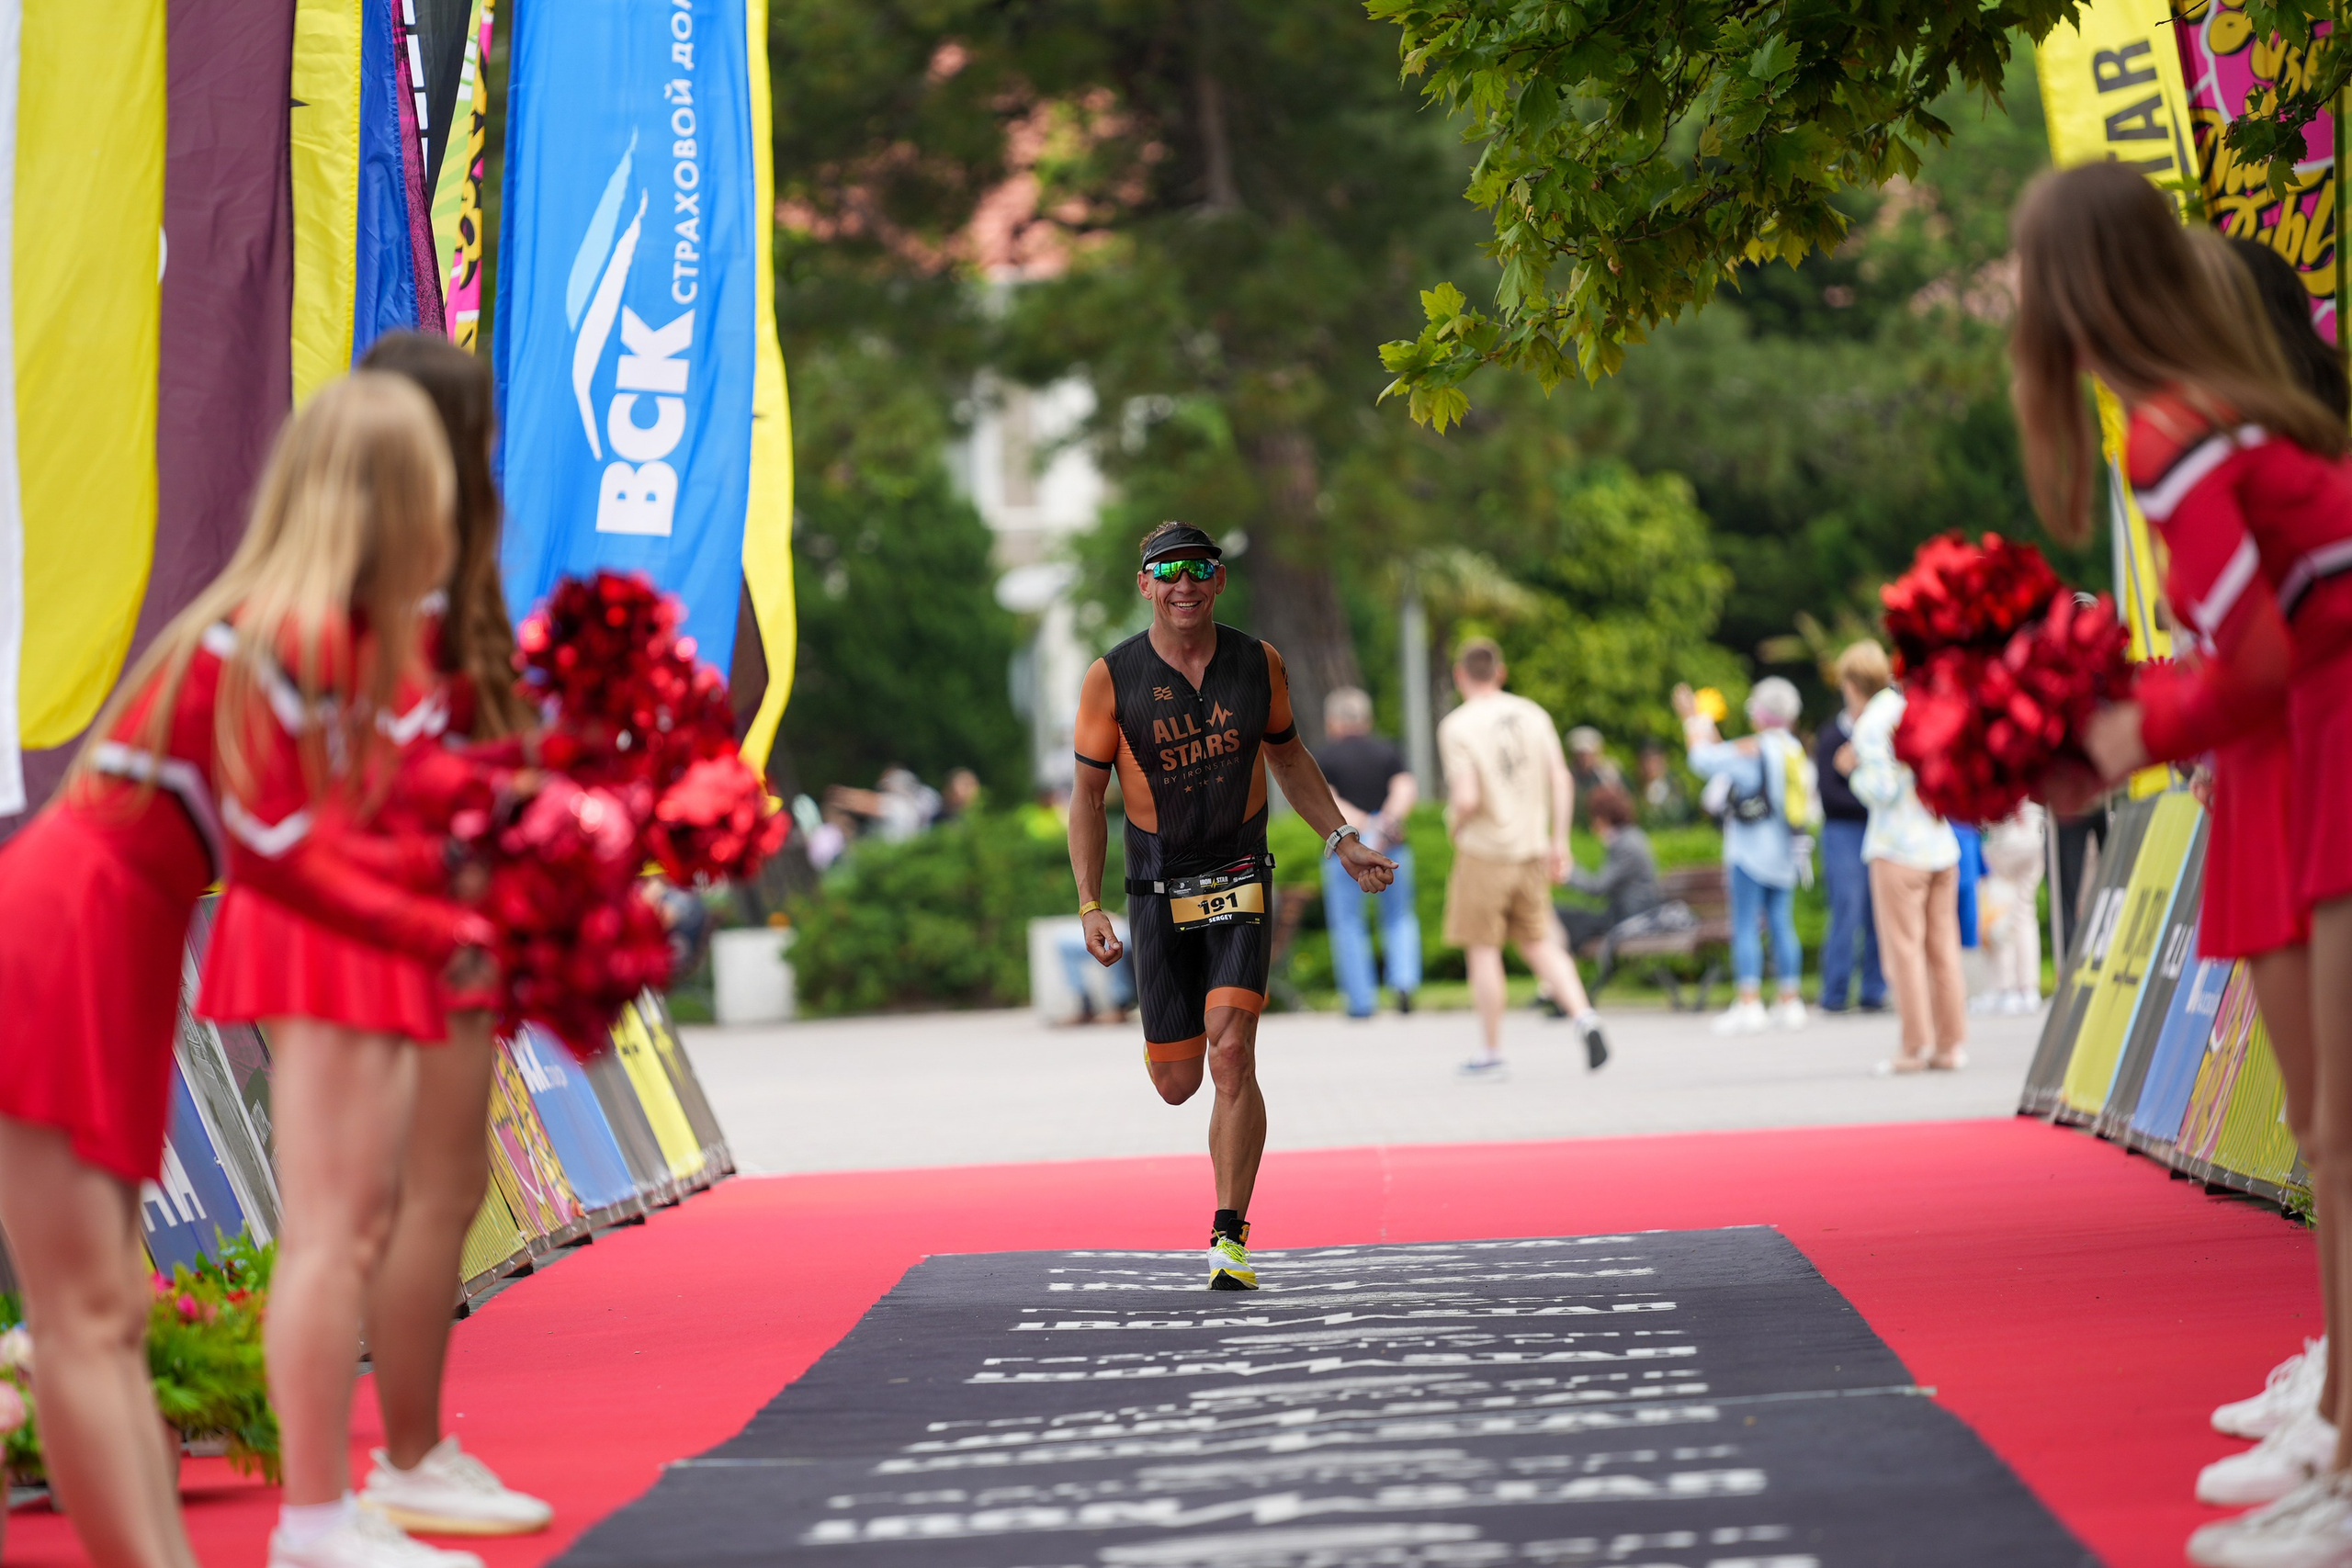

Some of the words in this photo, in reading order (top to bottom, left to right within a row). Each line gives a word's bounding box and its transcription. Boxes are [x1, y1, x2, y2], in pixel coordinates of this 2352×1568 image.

[2092, 39, 2174, 179] TAR
[664, 79, 700, 305] СТРАХОВОЙ
[595, 305, 695, 537] ВСК
[1153, 713, 1202, 744] ALL
[1159, 728, 1240, 772] STARS
[1163, 775, 1177, 784] BY
[1182, 757, 1240, 780] IRONSTAR
[1197, 892, 1238, 915] 191
[1208, 914, 1233, 923] SERGEY
